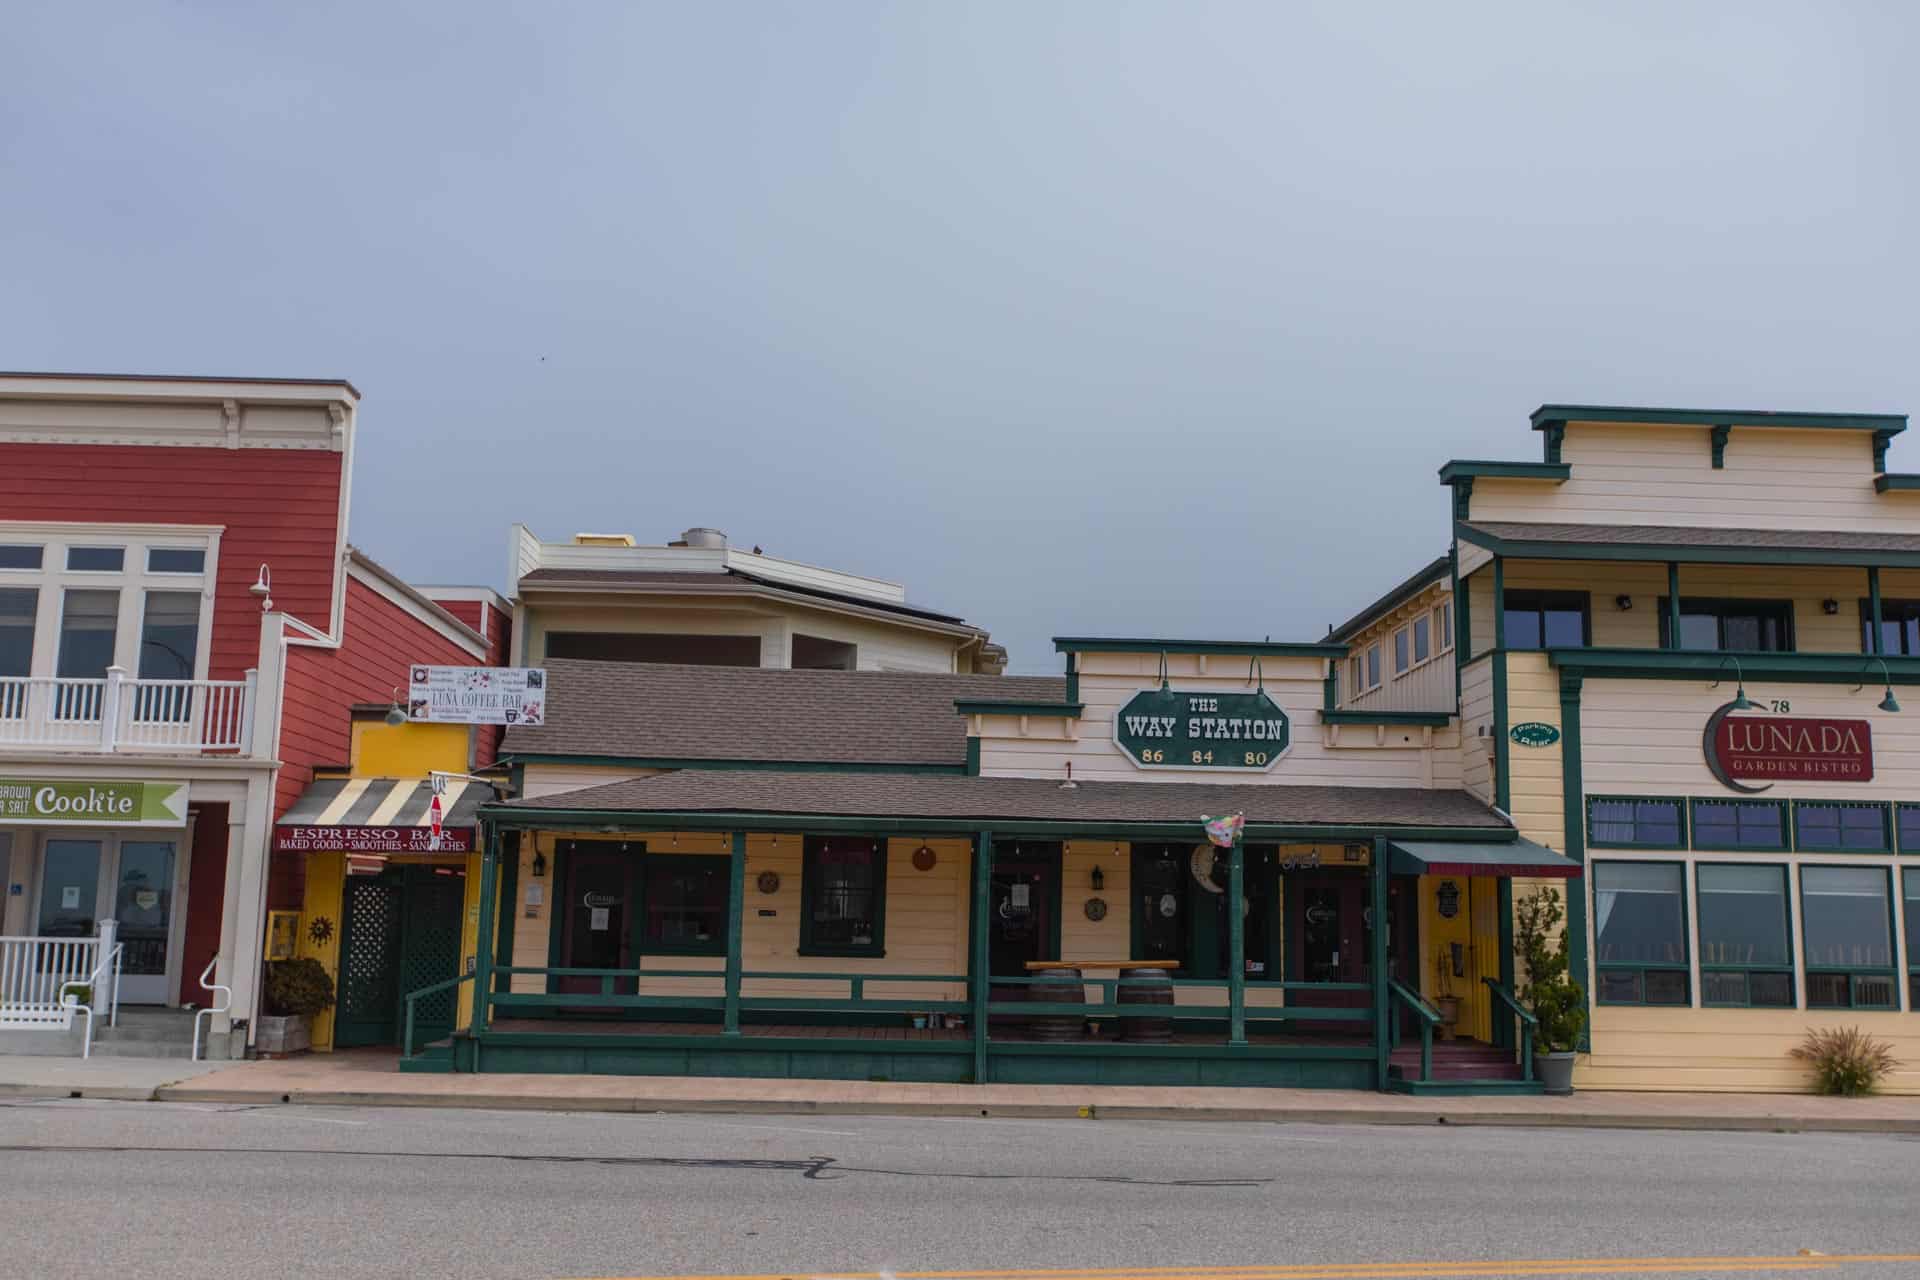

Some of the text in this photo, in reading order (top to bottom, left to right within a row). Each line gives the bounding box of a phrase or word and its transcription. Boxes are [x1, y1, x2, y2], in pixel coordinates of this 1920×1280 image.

[432, 692, 521, 708] LUNA COFFEE BAR
[1189, 698, 1218, 712] THE
[1771, 700, 1790, 713] 78
[1125, 716, 1282, 740] WAY STATION
[1728, 724, 1863, 754] LUNADA
[1142, 749, 1267, 765] 86 84 80
[1733, 760, 1861, 773] GARDEN BISTRO
[8, 800, 29, 813] SALT
[34, 786, 133, 814] Cookie
[292, 828, 454, 841] ESPRESSO BAR
[280, 839, 465, 851] BAKED GOODS SMOOTHIES SANICHES
